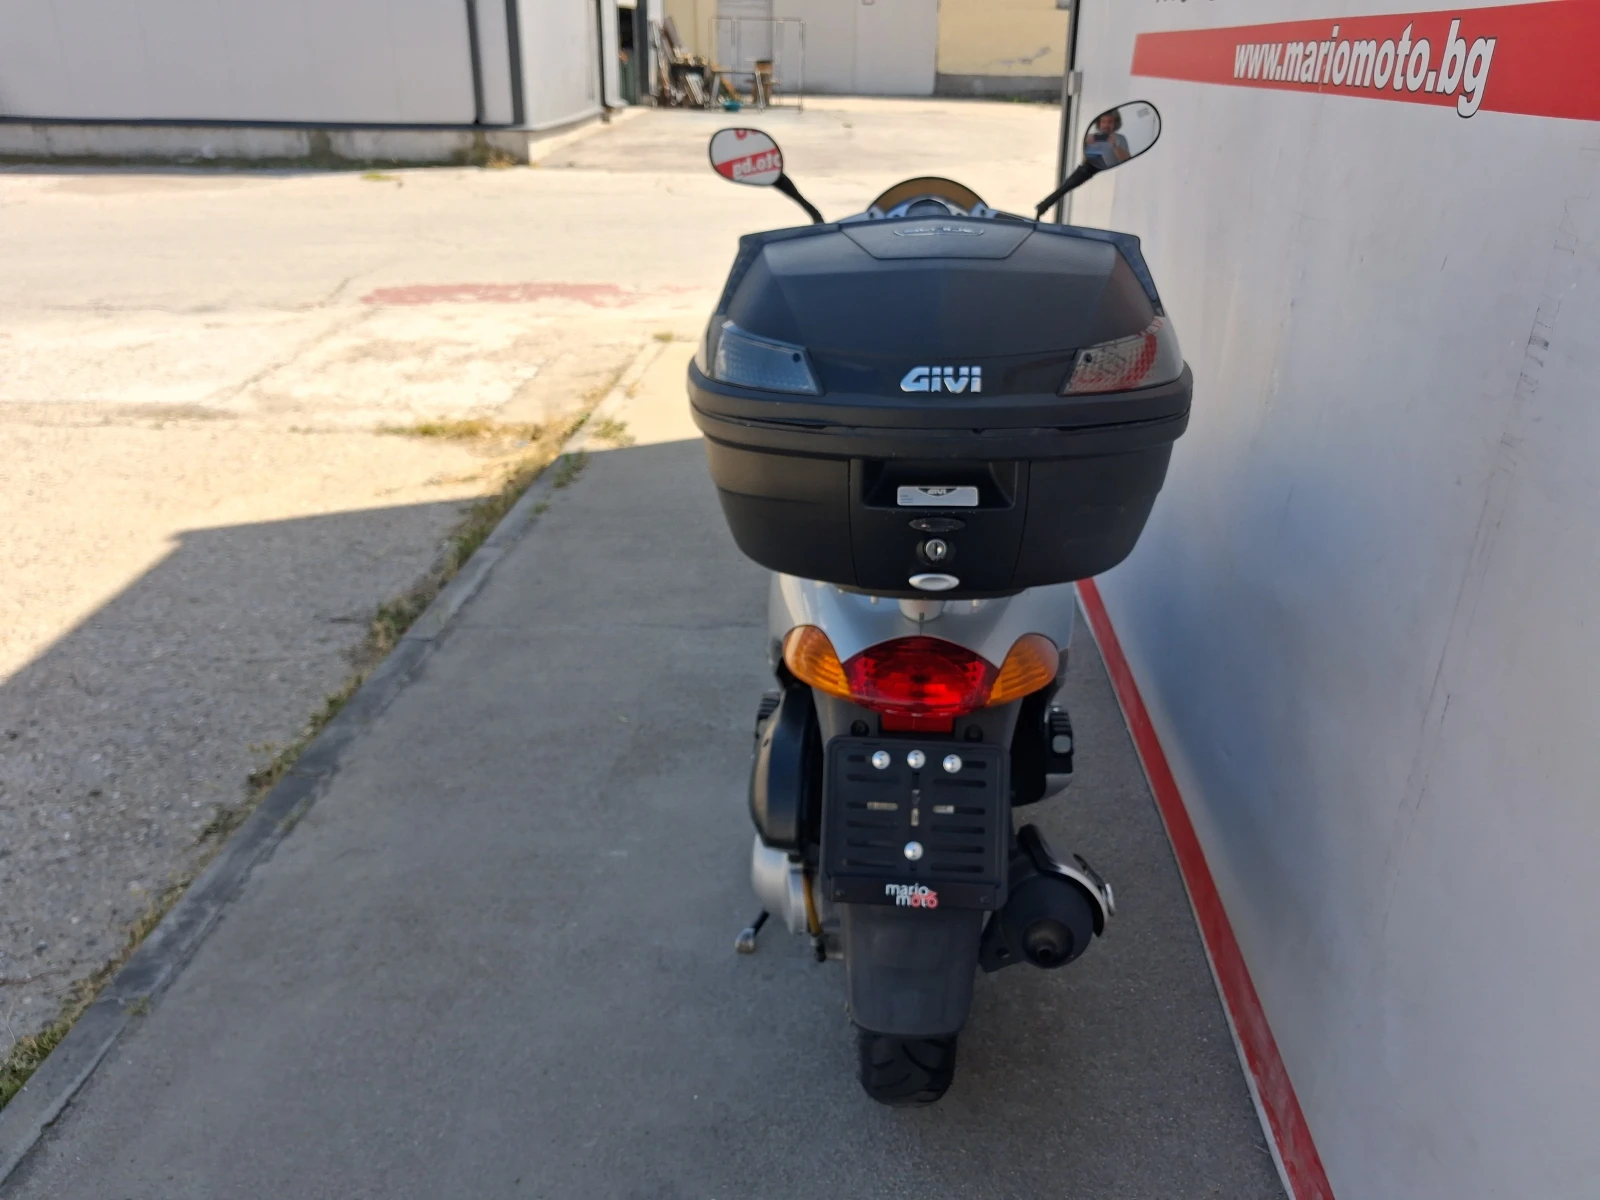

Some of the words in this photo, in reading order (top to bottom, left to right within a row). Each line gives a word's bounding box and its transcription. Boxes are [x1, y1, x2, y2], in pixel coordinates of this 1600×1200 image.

[1233, 17, 1497, 118] www.mariomoto.bg
[885, 882, 929, 896] mario
[896, 892, 939, 909] moto
